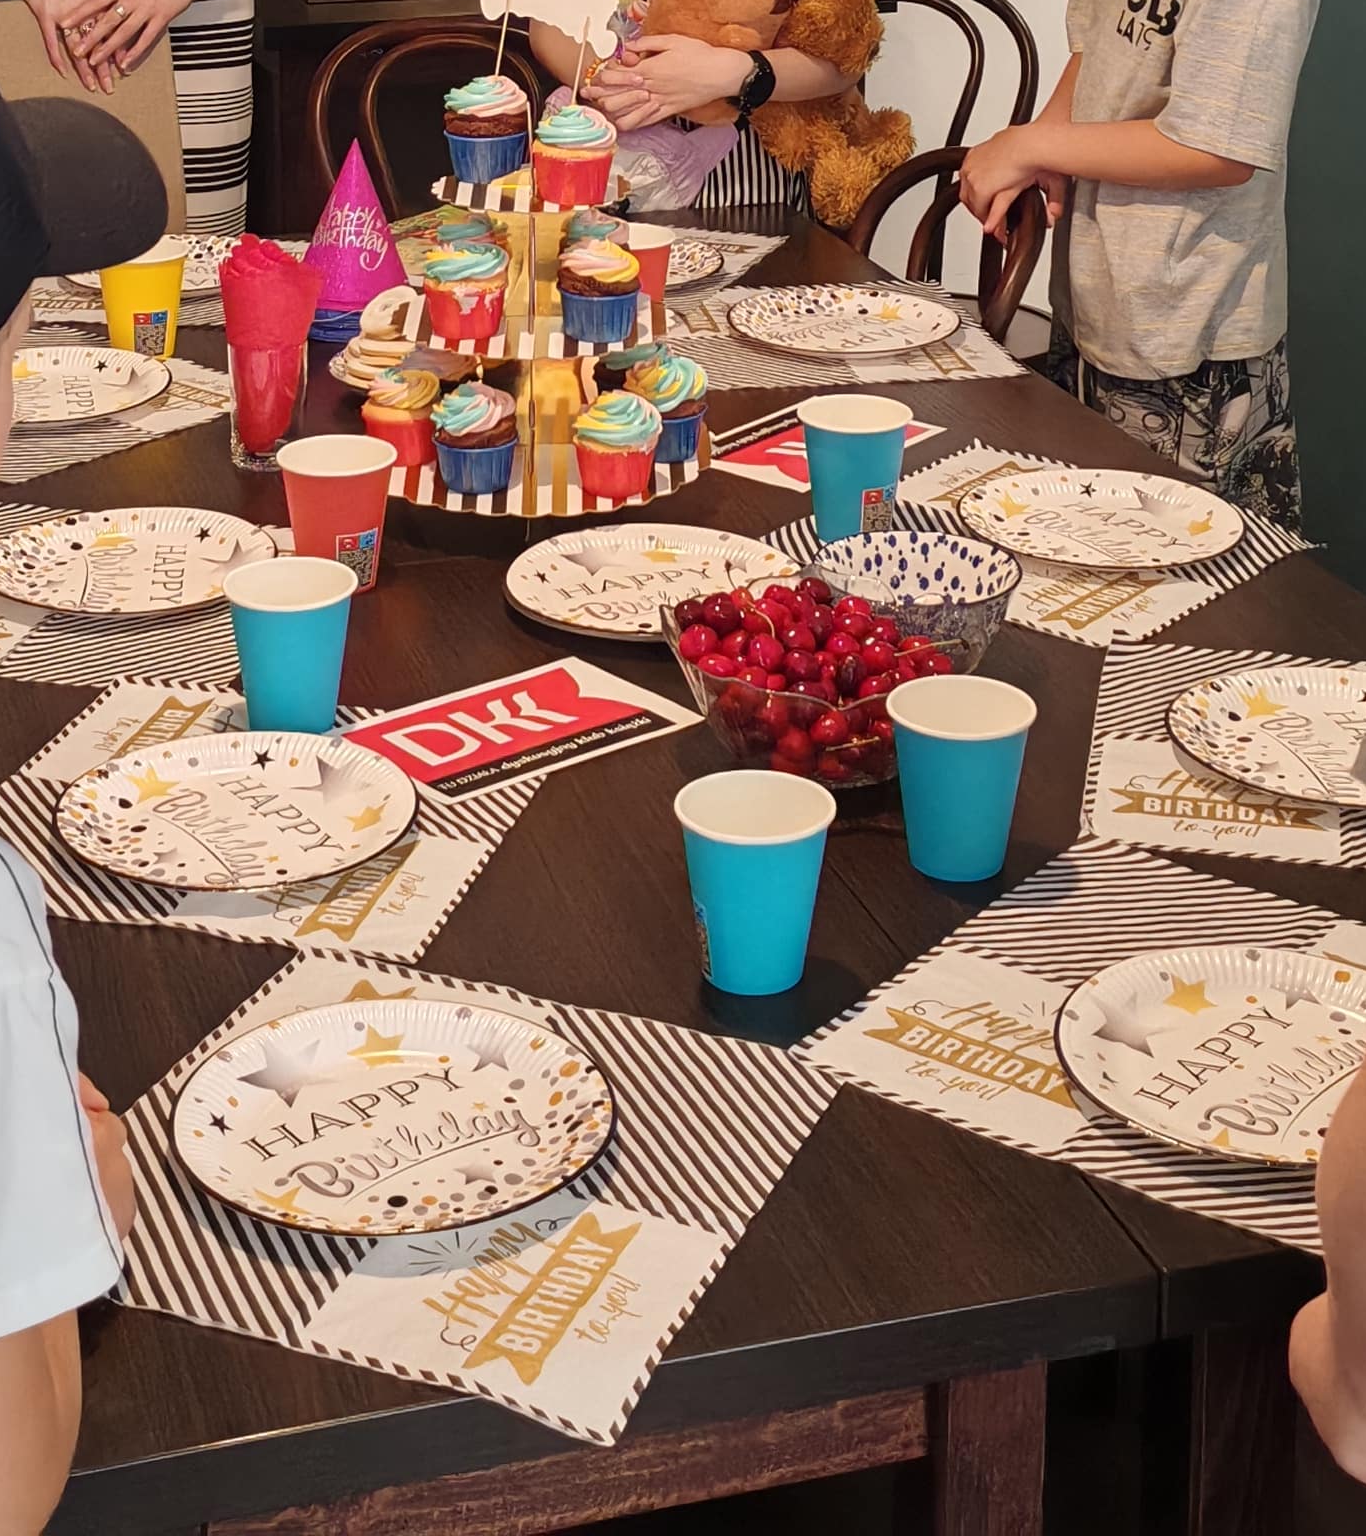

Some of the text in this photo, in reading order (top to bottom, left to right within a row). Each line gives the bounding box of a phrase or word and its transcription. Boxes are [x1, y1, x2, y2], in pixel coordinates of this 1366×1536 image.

[62, 375, 96, 417] HAPPY
[1061, 501, 1194, 548] HAPPY
[149, 544, 187, 605] HAPPY
[555, 566, 713, 601] HAPPY
[381, 690, 580, 766] DKK
[152, 788, 269, 885] Birthday
[217, 775, 346, 853] HAPPY
[1143, 797, 1298, 826] BIRTHDAY
[899, 1025, 1065, 1095] BIRTHDAY
[1133, 1005, 1293, 1111] HAPPY
[240, 1066, 465, 1162] HAPPY
[287, 1108, 541, 1199] Birthday
[422, 1221, 557, 1329] Happy
[494, 1235, 615, 1355] BIRTHDAY
